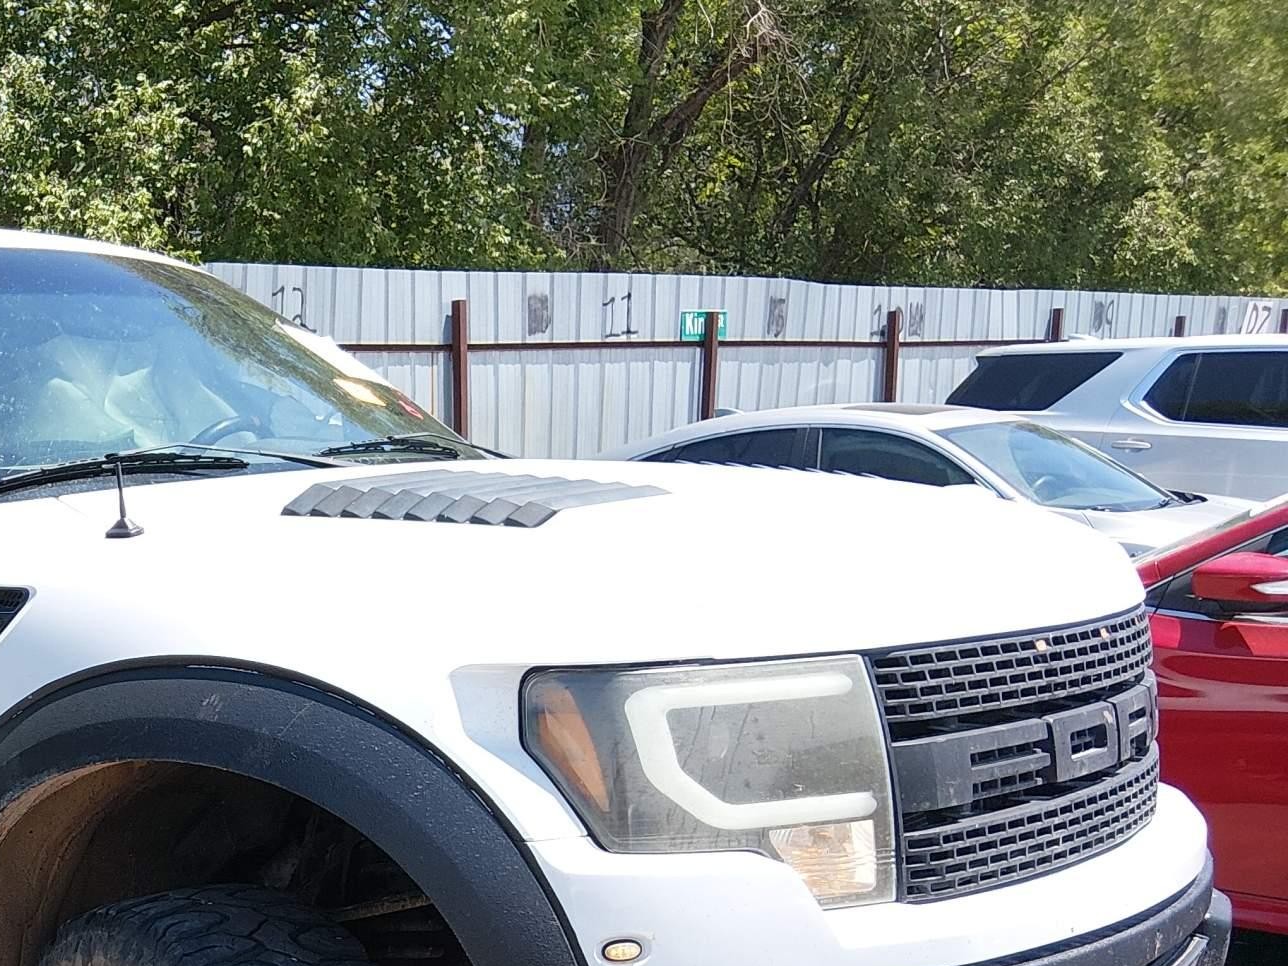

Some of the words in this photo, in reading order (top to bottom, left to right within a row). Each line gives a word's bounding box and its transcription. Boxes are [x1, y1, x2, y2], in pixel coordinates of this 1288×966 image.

[271, 285, 317, 333] 12
[602, 292, 639, 338] 11
[685, 312, 705, 335] Kin
[891, 667, 1158, 814] FOR
